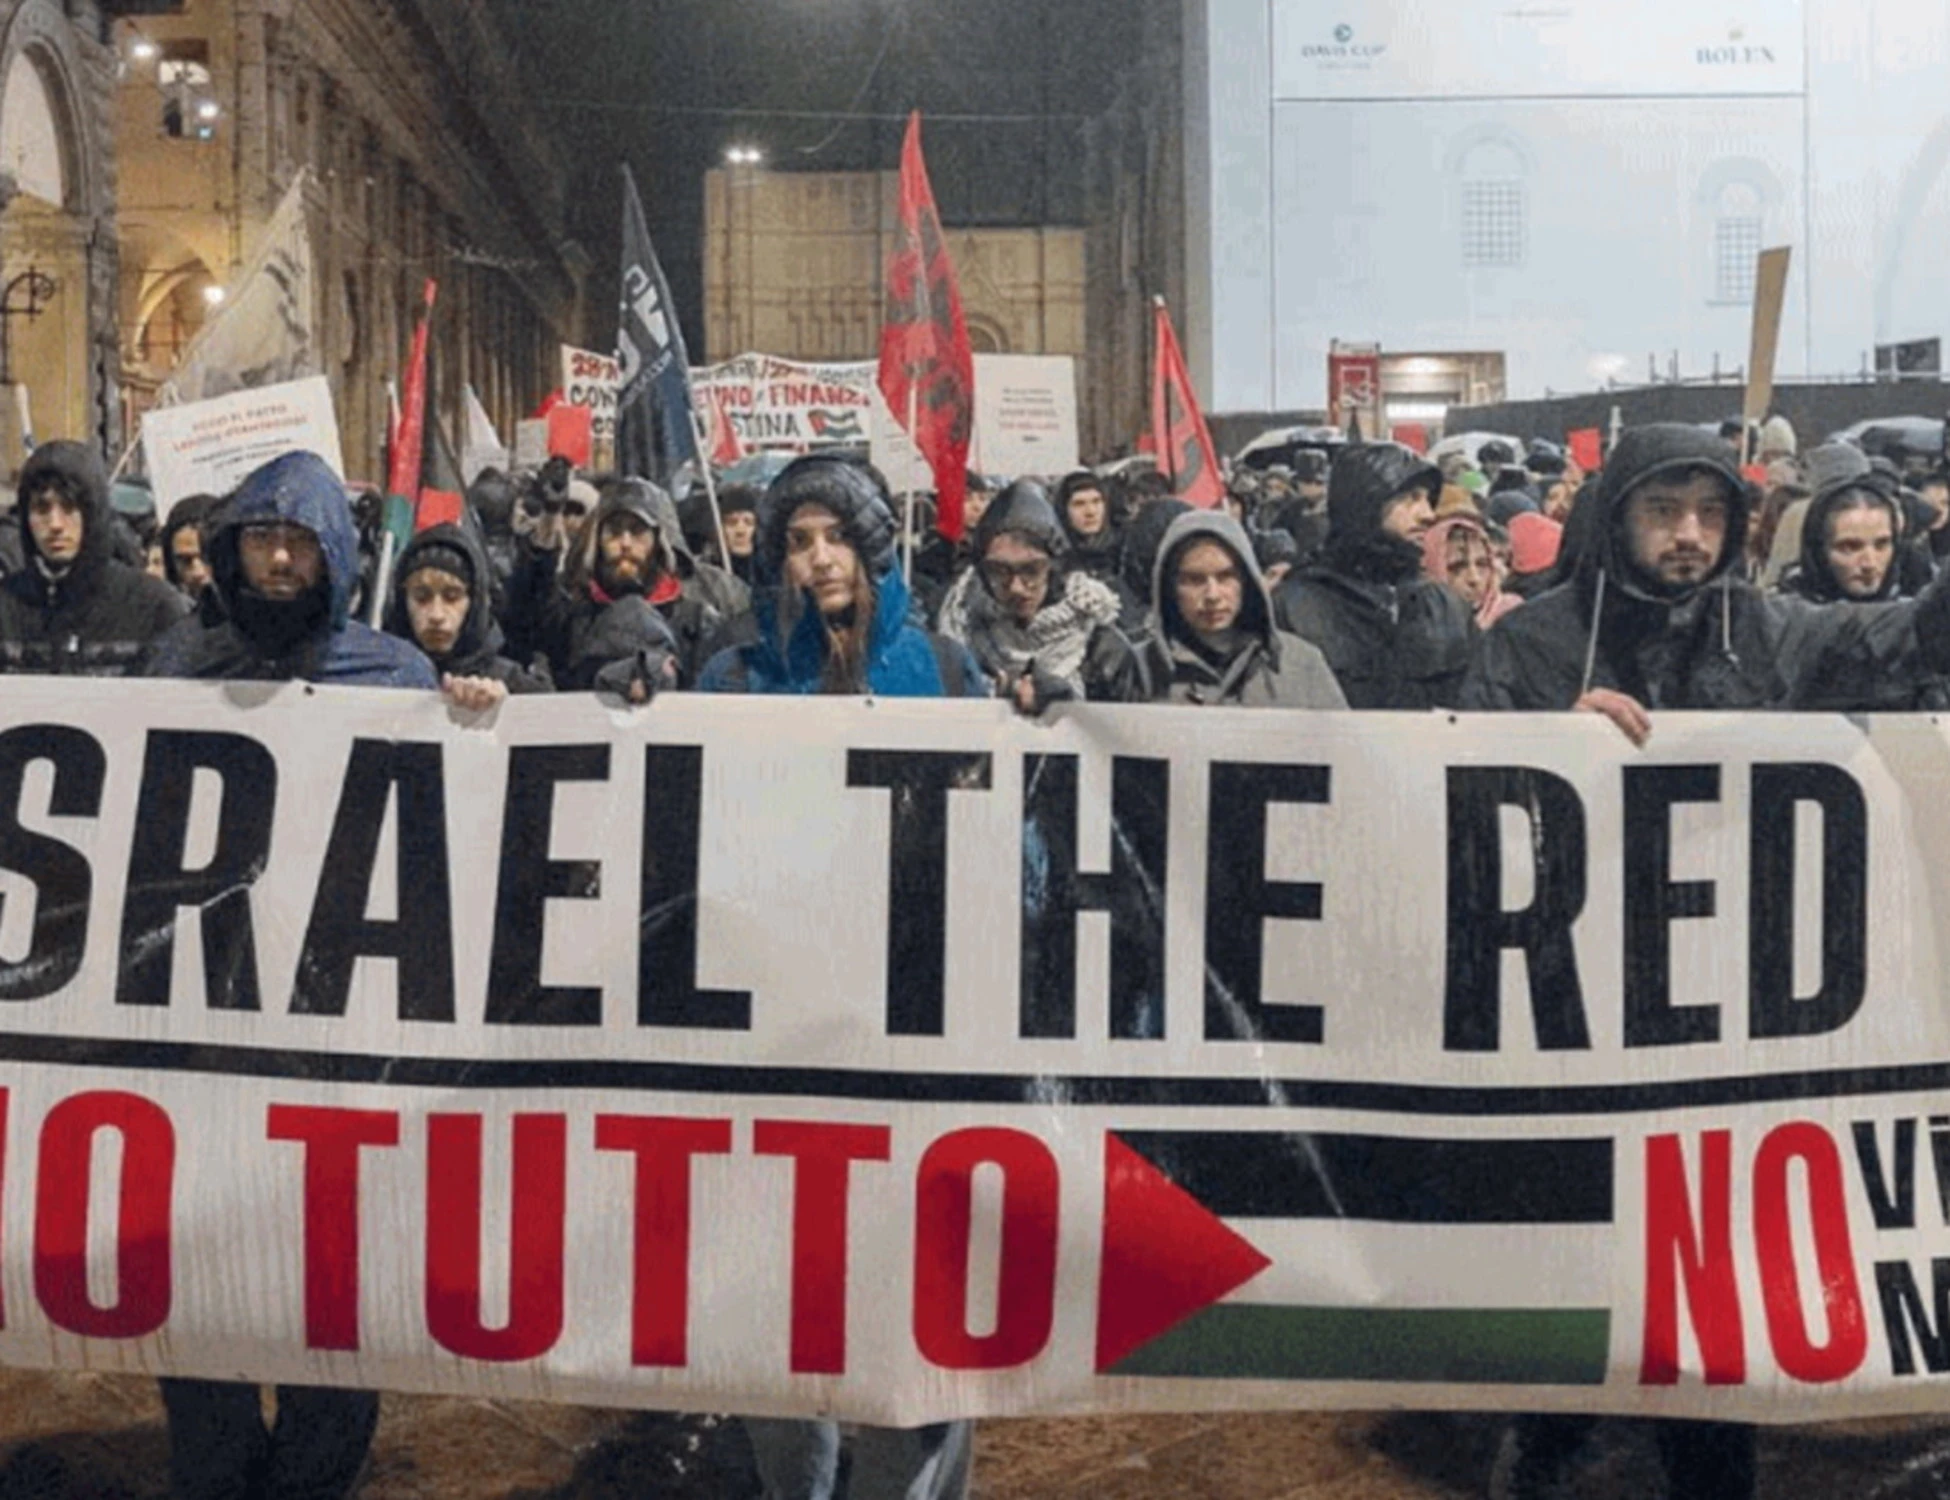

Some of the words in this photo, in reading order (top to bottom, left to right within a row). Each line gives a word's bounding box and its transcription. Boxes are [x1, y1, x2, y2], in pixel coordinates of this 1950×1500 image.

[0, 721, 754, 1034] SRAEL
[845, 748, 1332, 1046] THE
[1442, 759, 1870, 1053] RED
[0, 1087, 177, 1342] O
[266, 1102, 1062, 1378] TUTTO
[1637, 1120, 1869, 1386] NO
